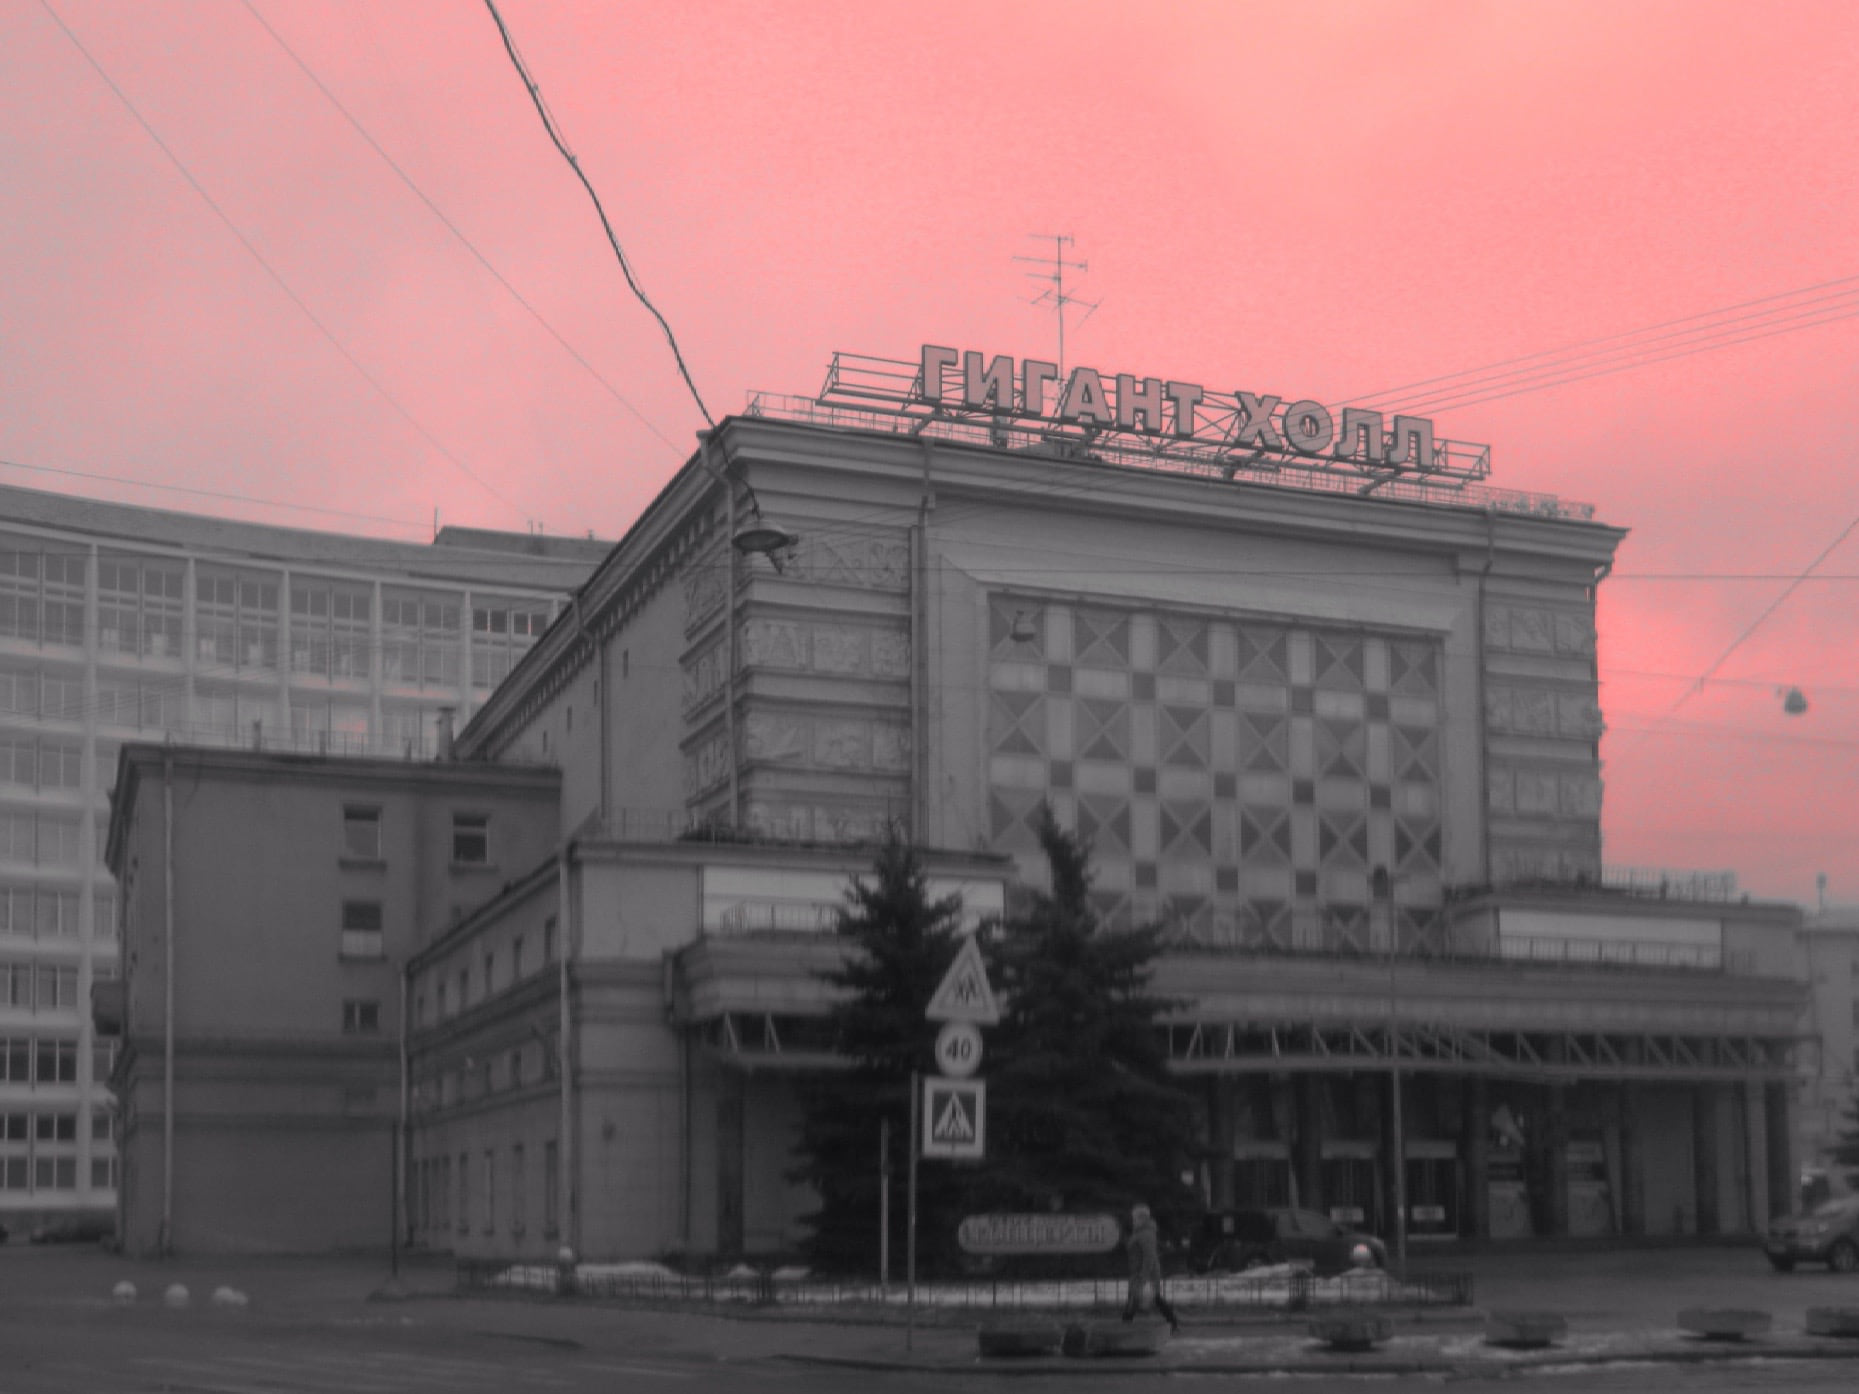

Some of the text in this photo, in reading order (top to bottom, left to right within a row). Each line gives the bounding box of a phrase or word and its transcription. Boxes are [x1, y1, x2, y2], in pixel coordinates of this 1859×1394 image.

[920, 344, 1435, 468] ГИГАНТ ХОЛЛ
[945, 1037, 972, 1061] 40
